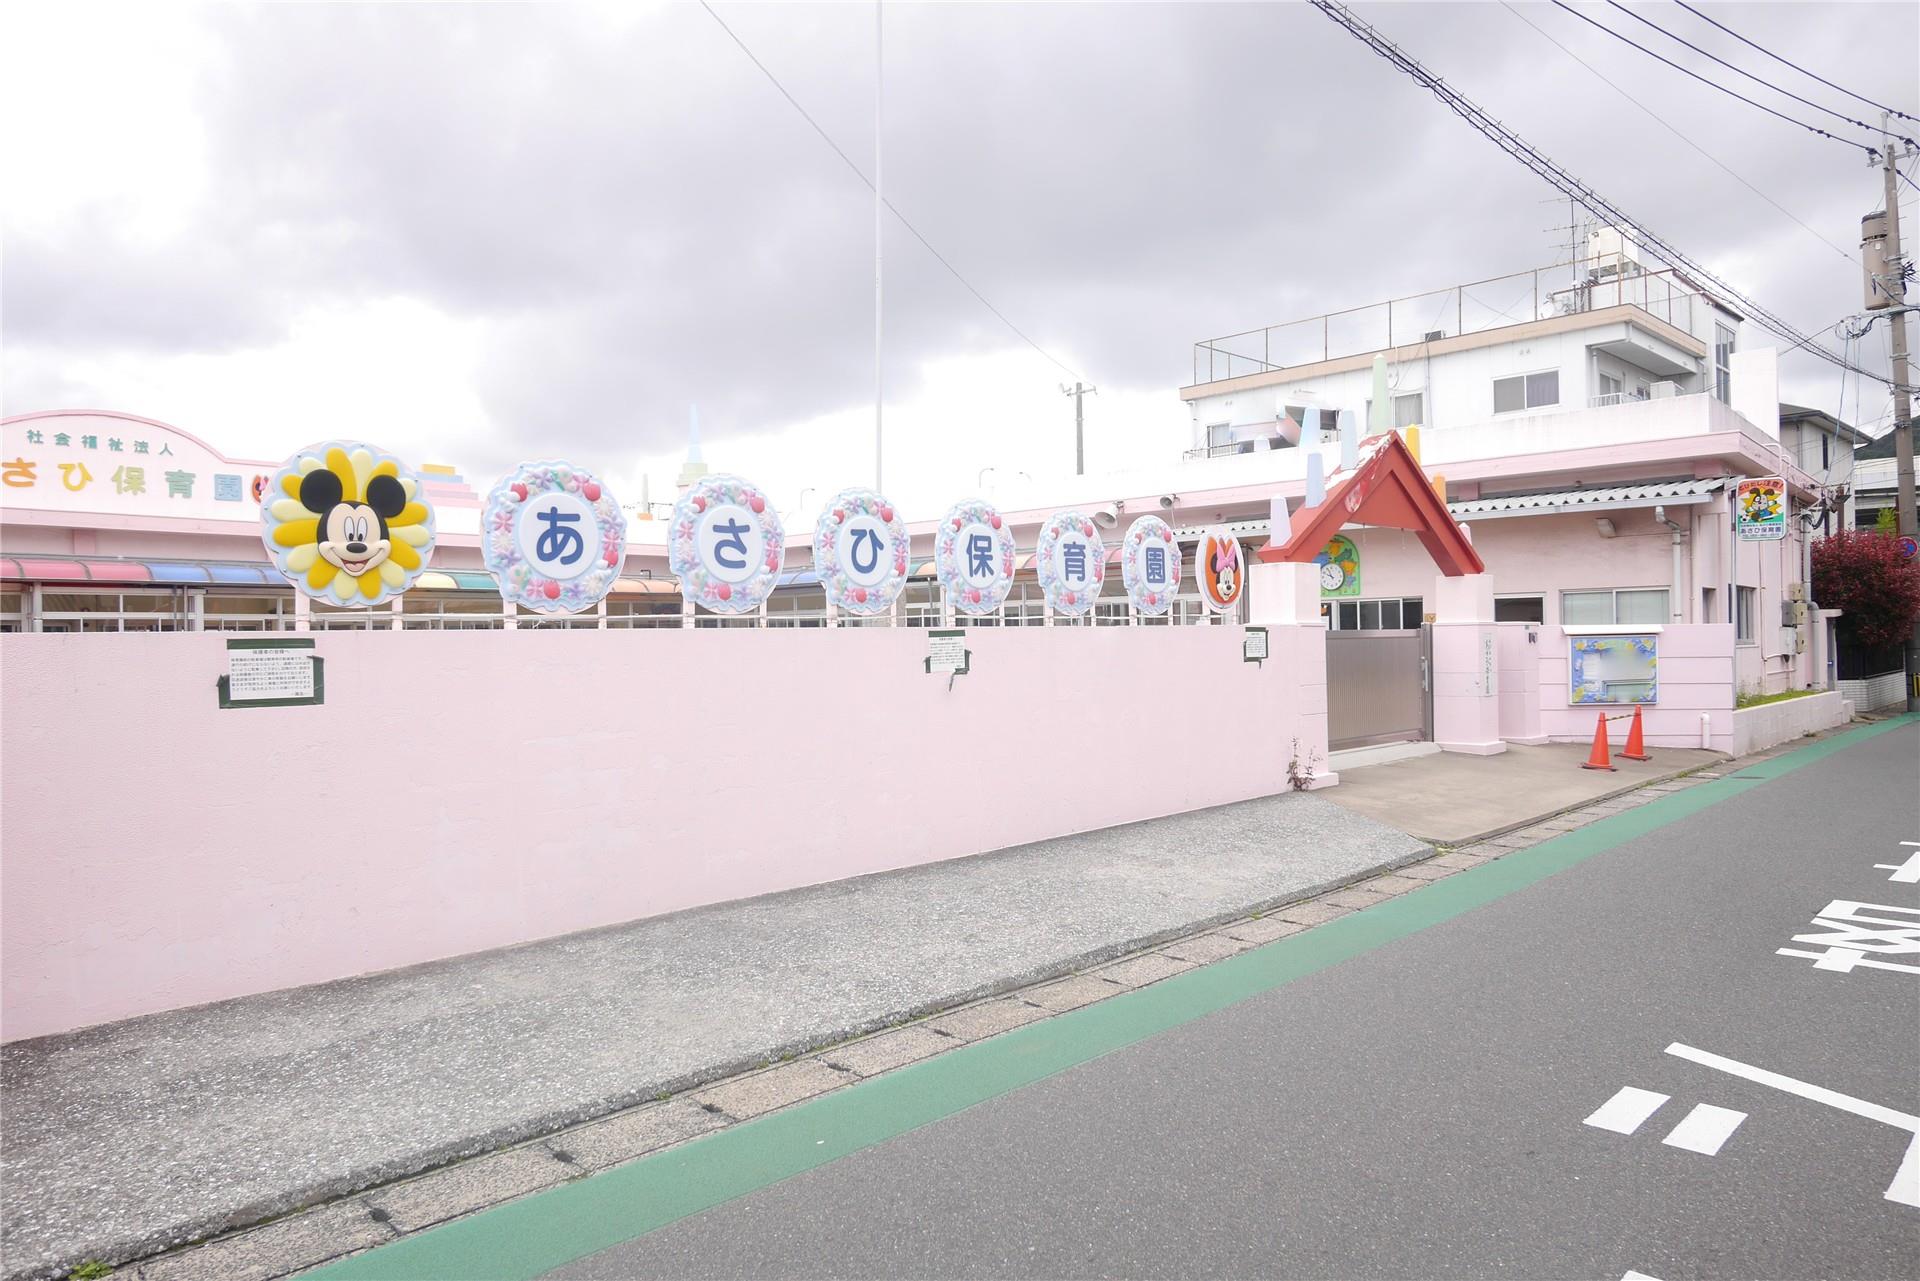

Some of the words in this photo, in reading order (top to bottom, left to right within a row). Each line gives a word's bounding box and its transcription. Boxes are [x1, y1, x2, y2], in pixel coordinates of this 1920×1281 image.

[26, 428, 174, 456] 社会福祉法人
